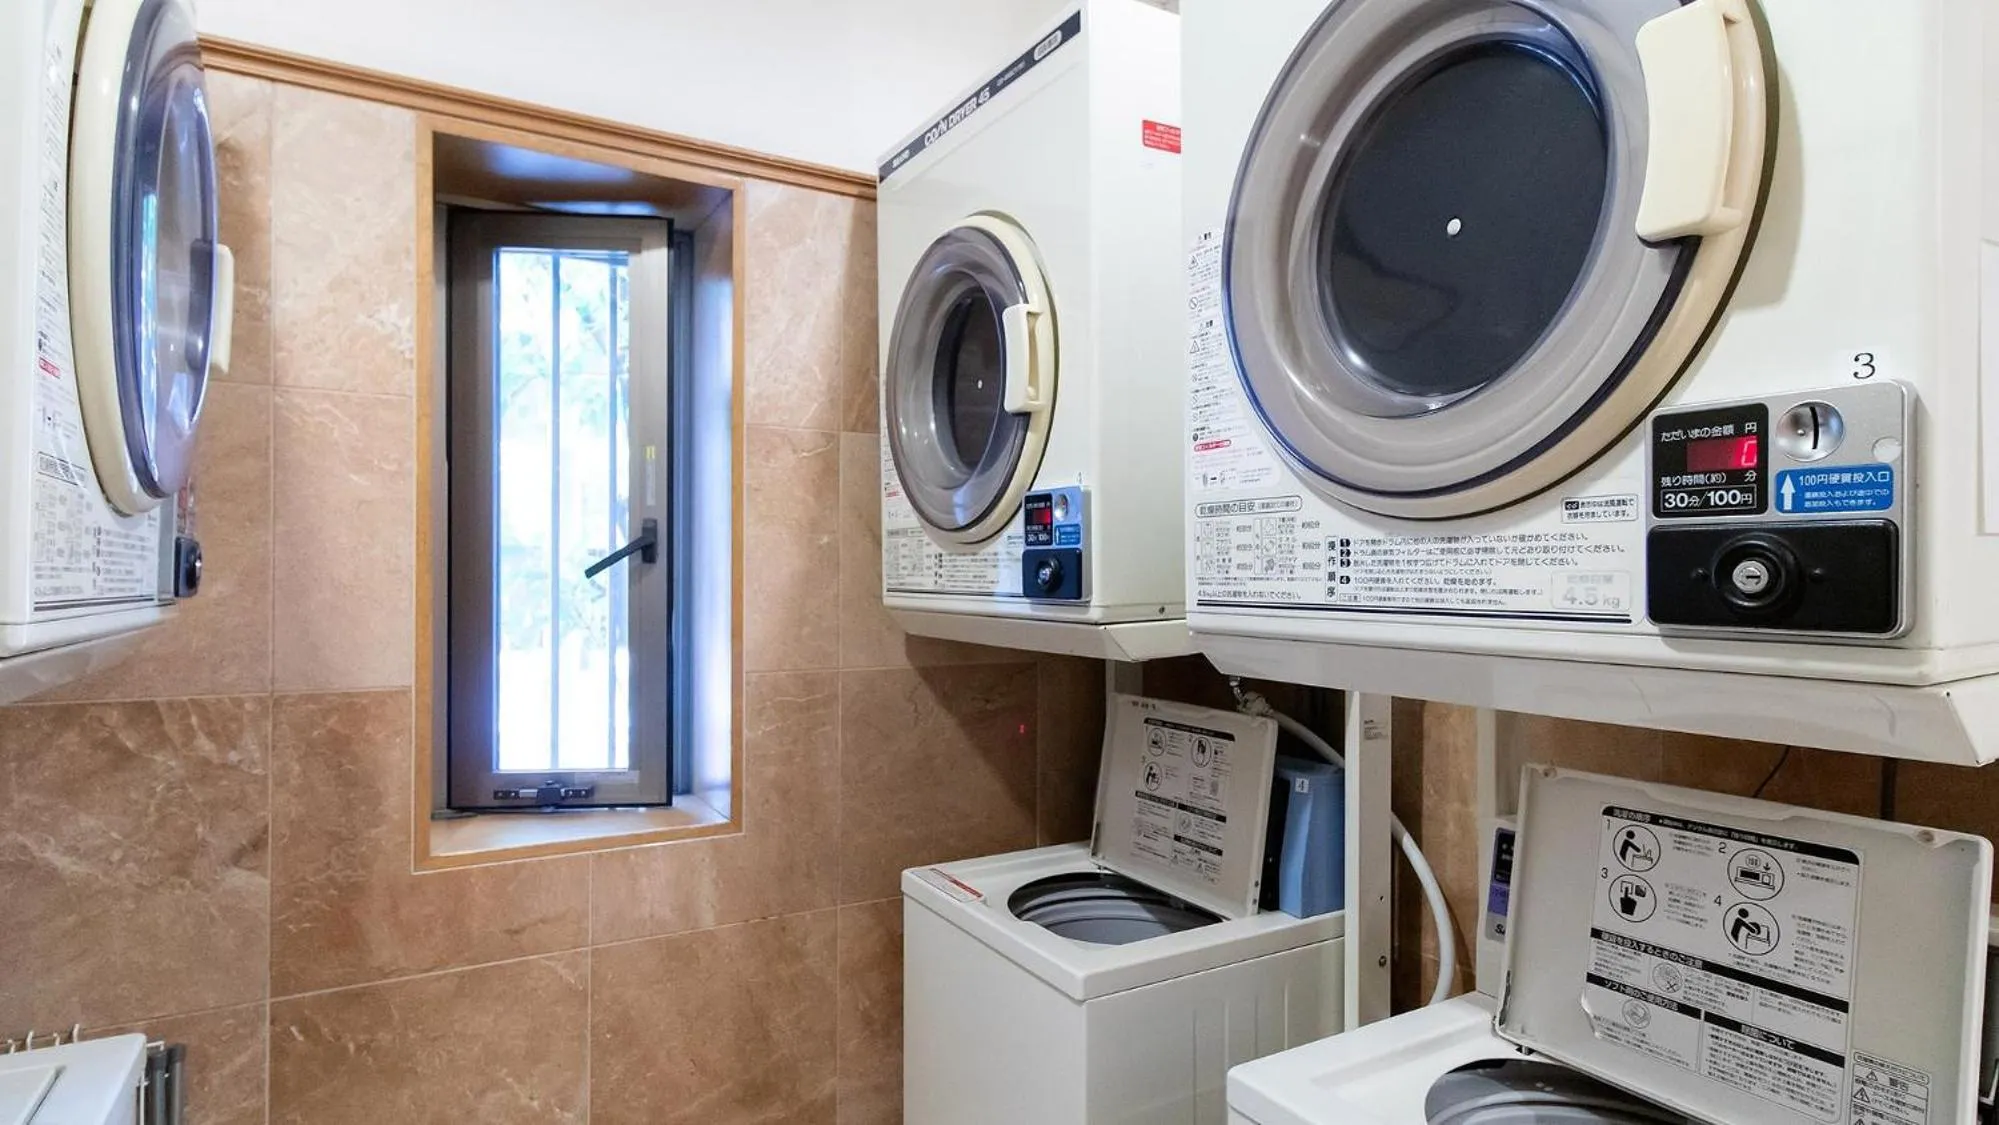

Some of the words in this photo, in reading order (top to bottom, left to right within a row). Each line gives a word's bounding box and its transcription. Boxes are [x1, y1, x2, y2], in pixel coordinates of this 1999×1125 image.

[948, 97, 978, 128] DRYER
[977, 88, 990, 104] 45
[1852, 353, 1876, 380] 3
[1660, 424, 1735, 442] ただいまの金額
[1744, 421, 1757, 434] 円
[1744, 470, 1757, 483] 分
[1799, 471, 1890, 486] 100円硬貨投入口
[1607, 819, 1611, 830] 1
[1718, 841, 1727, 854] 2
[1601, 867, 1609, 879] 3
[1714, 895, 1722, 906] 4
